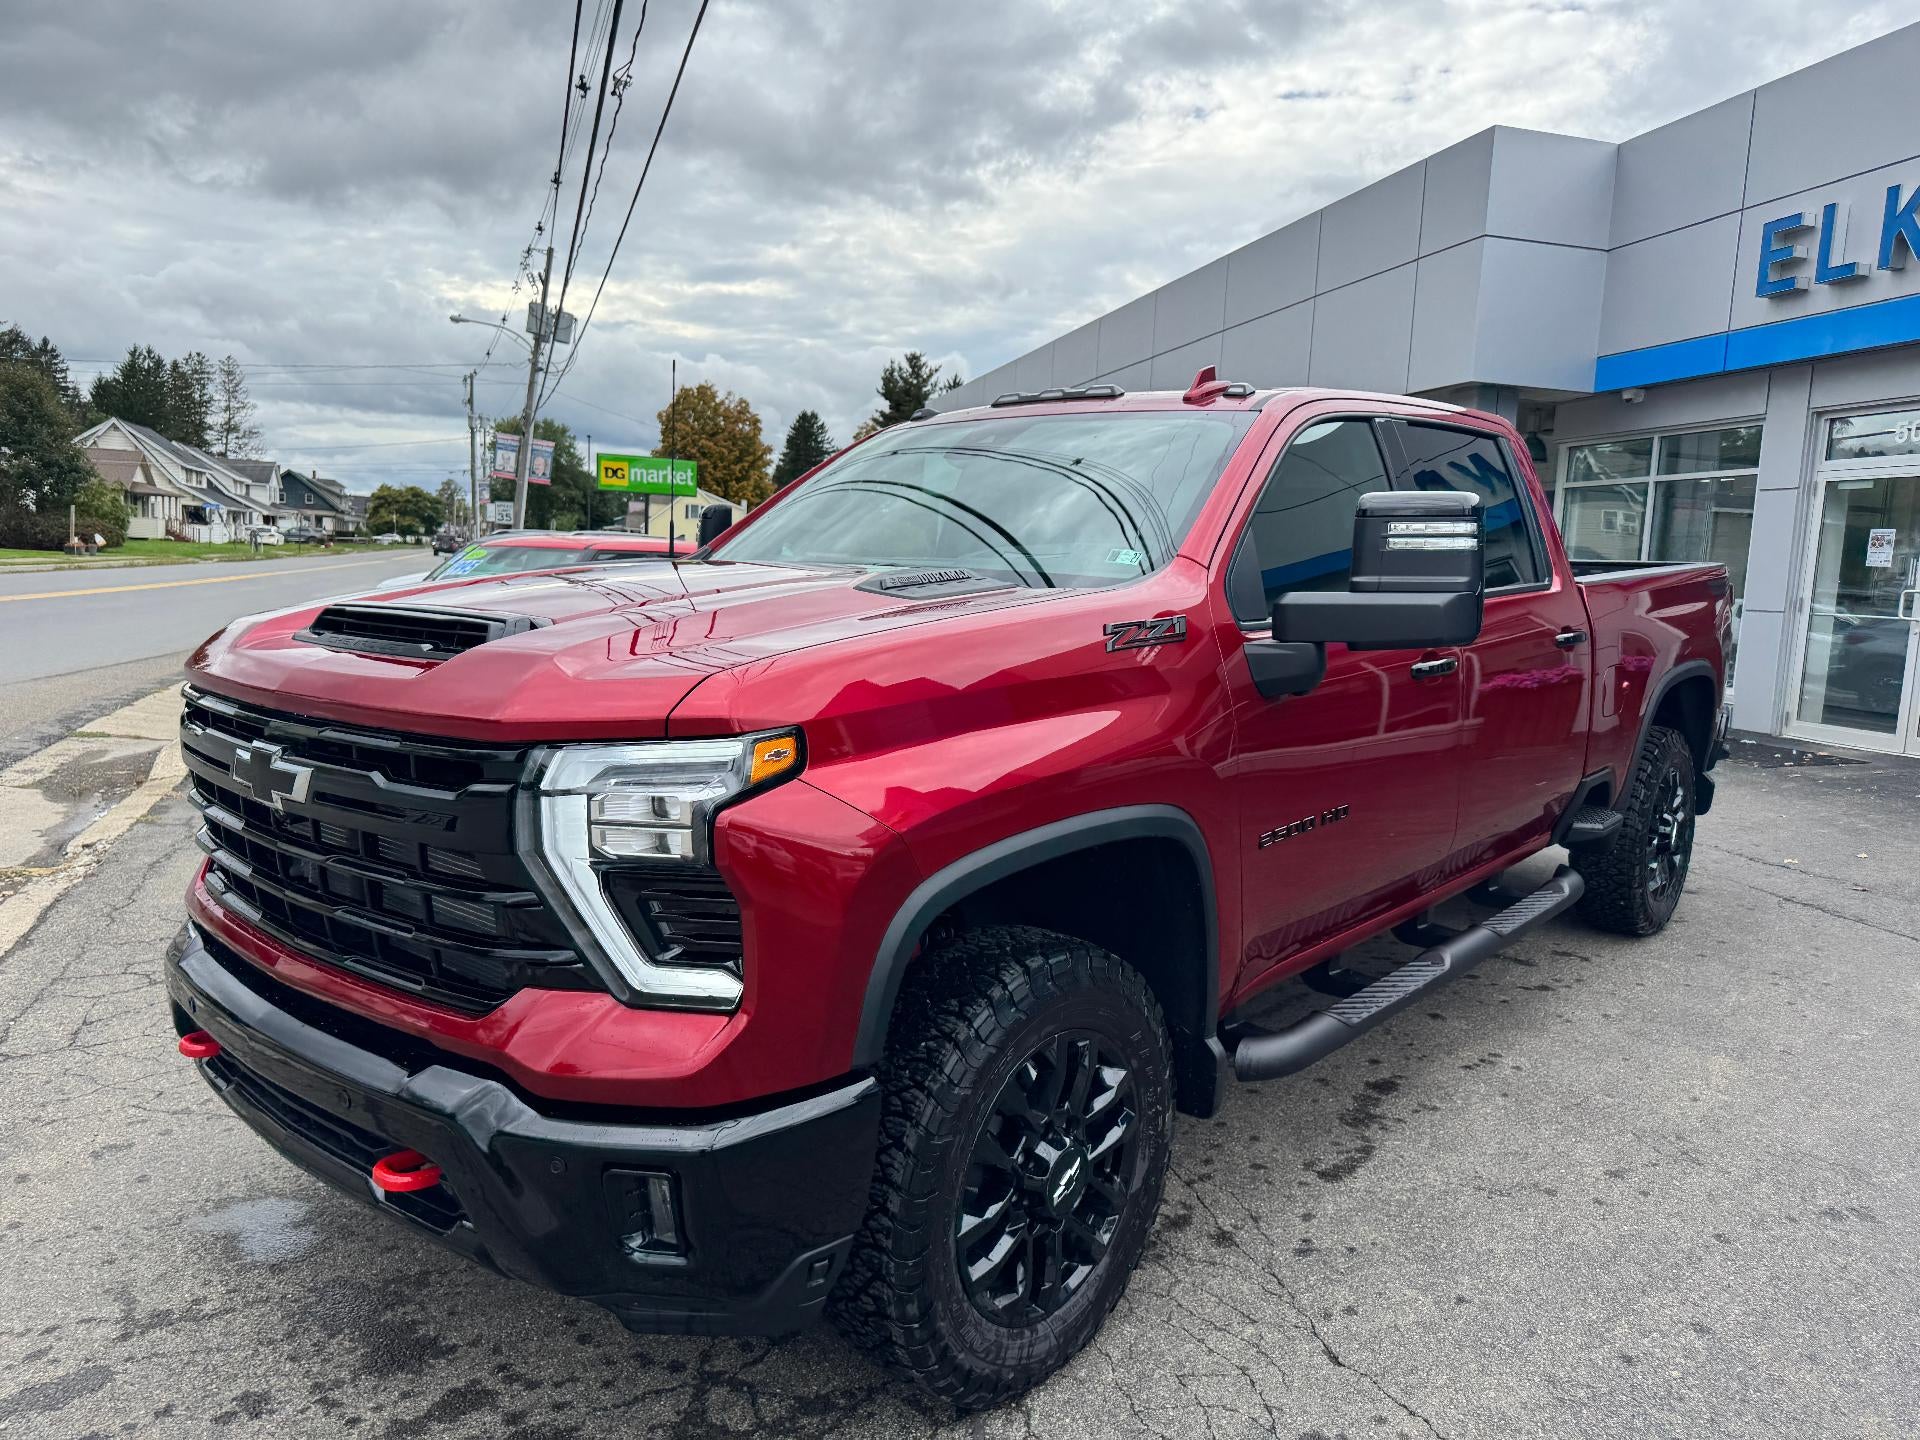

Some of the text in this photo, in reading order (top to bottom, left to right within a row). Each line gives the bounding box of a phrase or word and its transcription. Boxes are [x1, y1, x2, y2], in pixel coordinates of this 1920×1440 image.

[604, 466, 694, 486] DG market
[497, 512, 512, 522] 35
[918, 568, 971, 584] DURAMAX
[1103, 614, 1187, 653] Z71
[1258, 804, 1350, 849] 2500 HD
